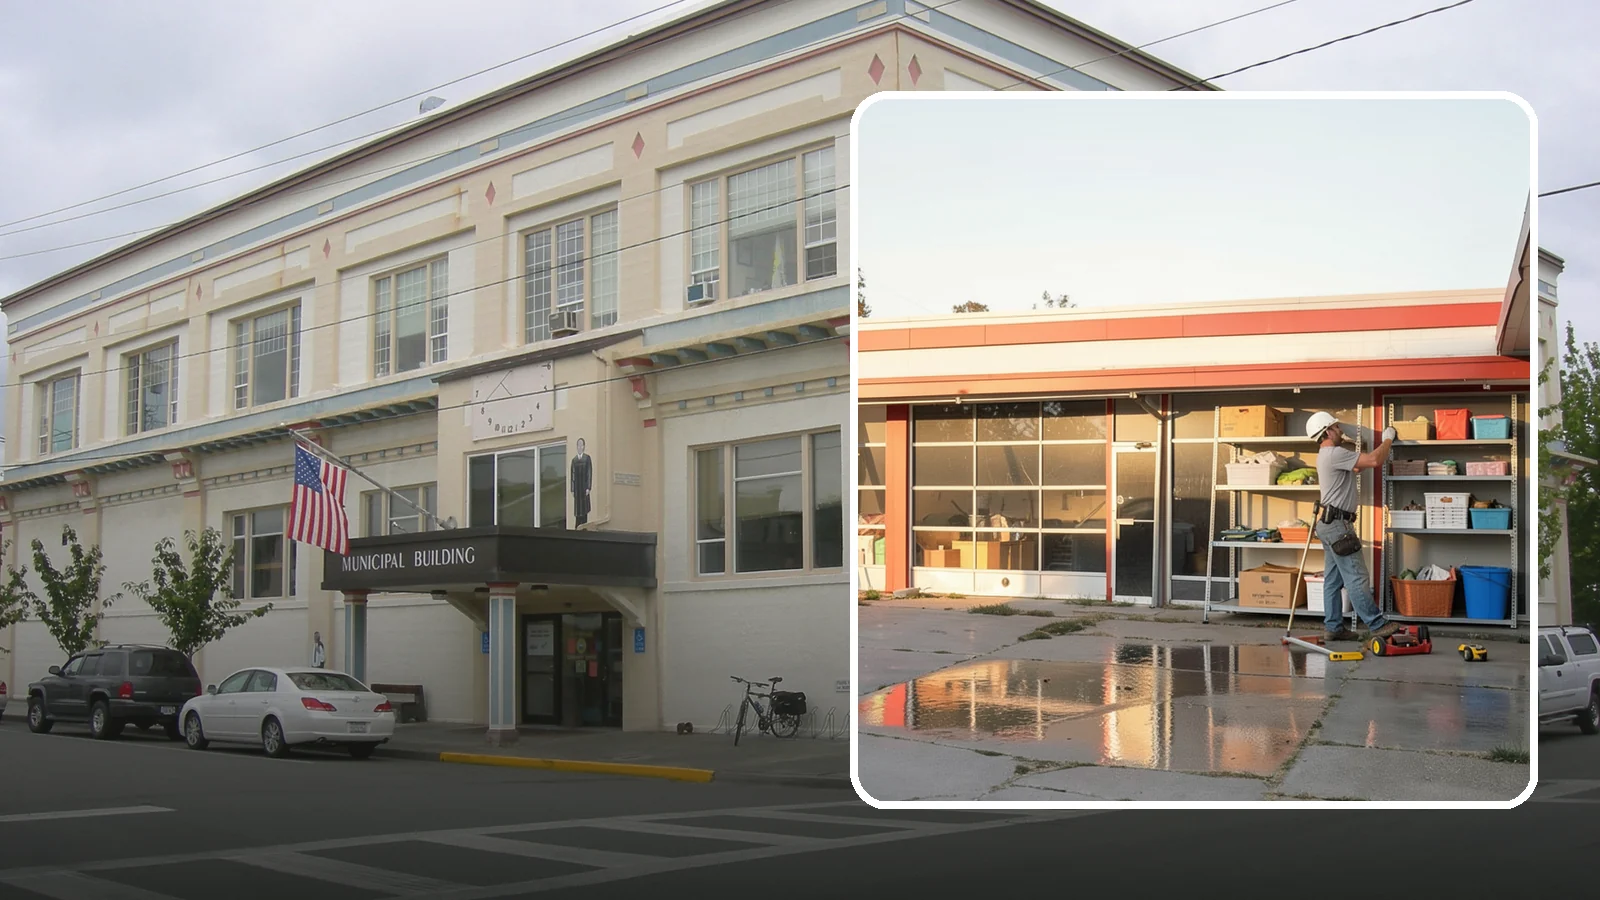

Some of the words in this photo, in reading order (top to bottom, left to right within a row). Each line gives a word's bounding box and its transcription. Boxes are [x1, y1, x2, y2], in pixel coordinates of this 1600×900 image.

[475, 390, 479, 398] 7
[536, 402, 540, 410] 4
[480, 407, 485, 415] 8
[487, 417, 492, 426] 9
[528, 414, 533, 422] 3
[521, 420, 525, 428] 2
[494, 423, 500, 432] 10
[501, 425, 506, 434] 11
[507, 425, 513, 433] 12
[342, 552, 405, 572] MUNICIPAL
[414, 546, 475, 567] BUILDING
